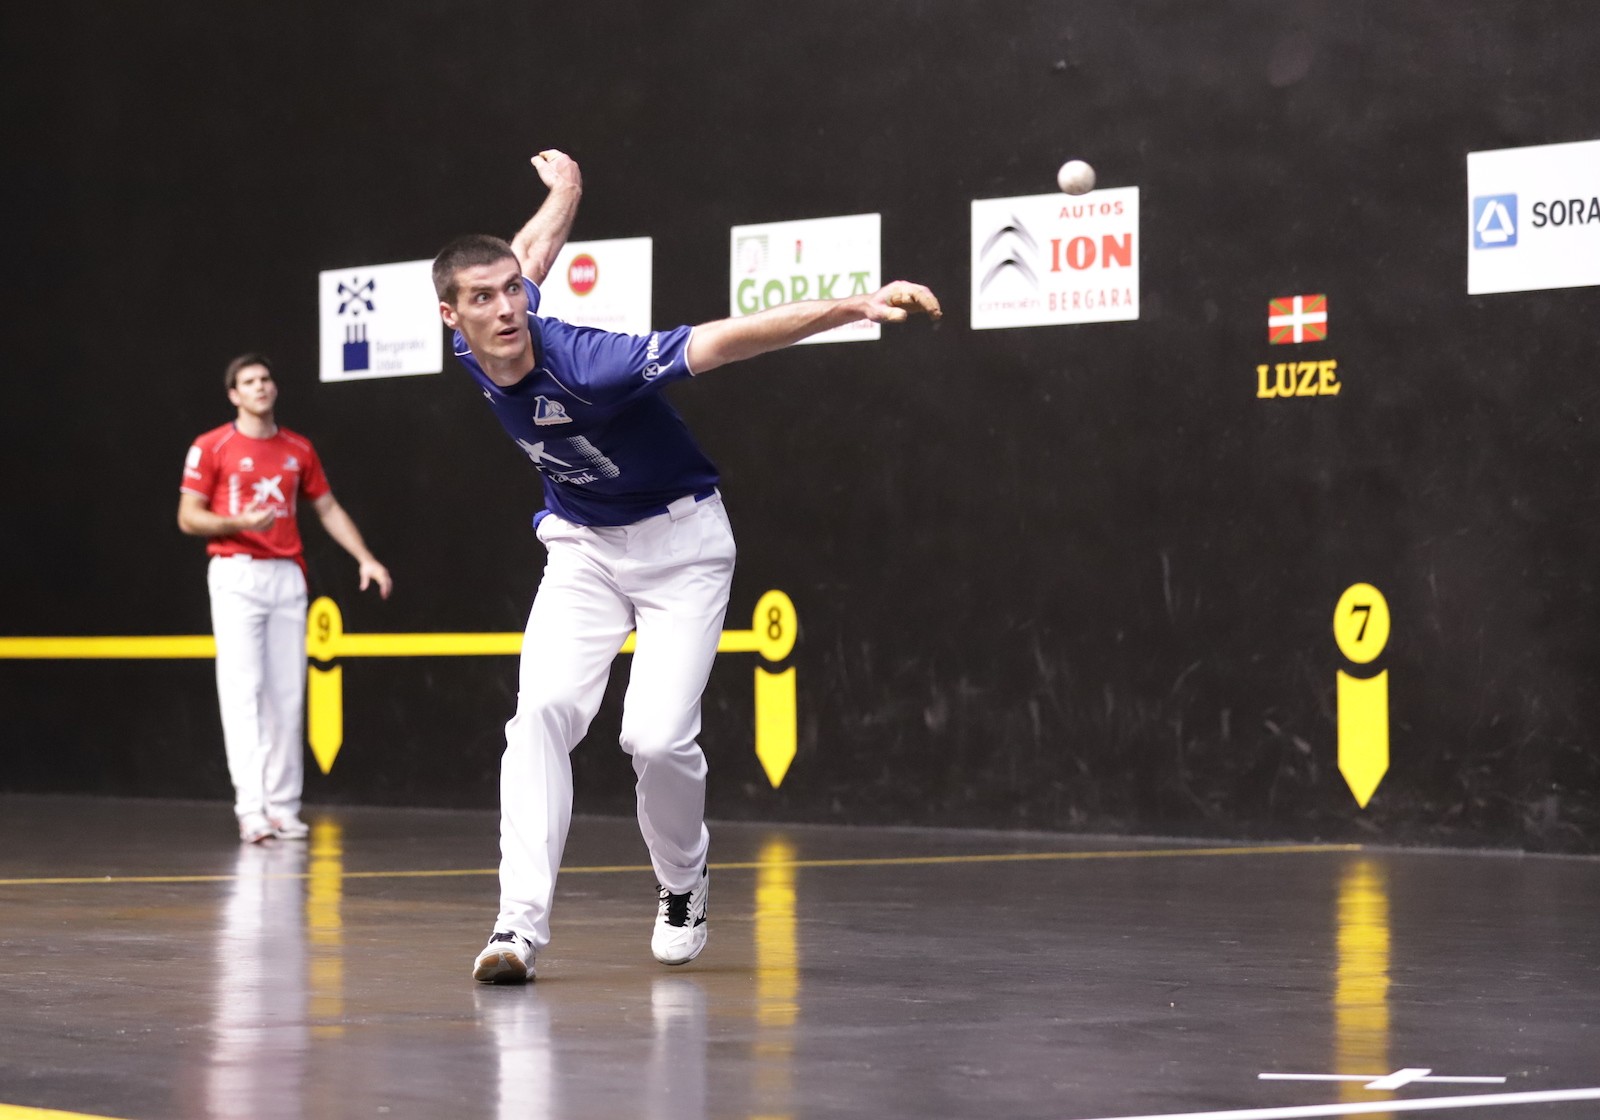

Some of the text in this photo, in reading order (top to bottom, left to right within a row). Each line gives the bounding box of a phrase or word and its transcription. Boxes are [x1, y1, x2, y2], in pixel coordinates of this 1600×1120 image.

[1059, 201, 1124, 219] AUTOS
[1532, 197, 1600, 228] SORA
[1050, 233, 1132, 272] ION
[737, 271, 870, 316] GORKA
[1049, 288, 1132, 311] BERGARA
[1256, 359, 1341, 398] LUZE
[317, 611, 331, 643] 9
[768, 605, 782, 641] 8
[1350, 605, 1371, 642] 7
